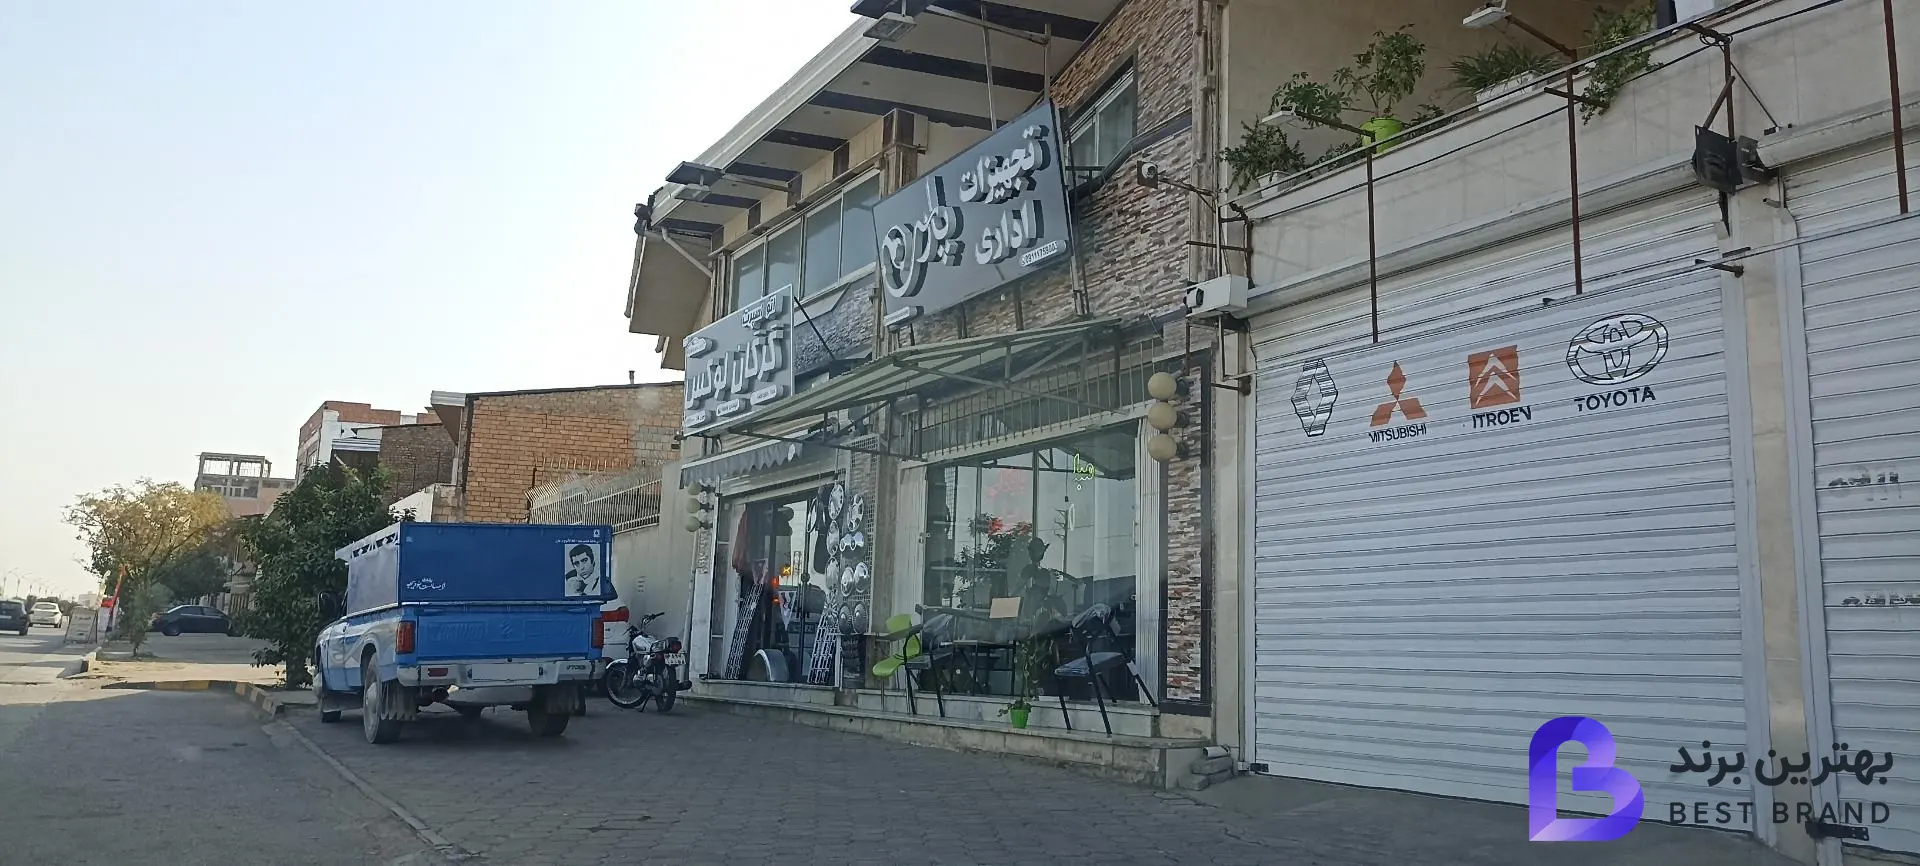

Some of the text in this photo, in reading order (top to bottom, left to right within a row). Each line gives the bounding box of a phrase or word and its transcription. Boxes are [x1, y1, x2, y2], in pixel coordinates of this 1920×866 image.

[959, 124, 1044, 205] تجهیزات
[975, 199, 1040, 265] اداری
[685, 323, 782, 411] گرگان لوکس
[1573, 386, 1657, 412] TOYOTA
[1470, 406, 1533, 429] ITROEN
